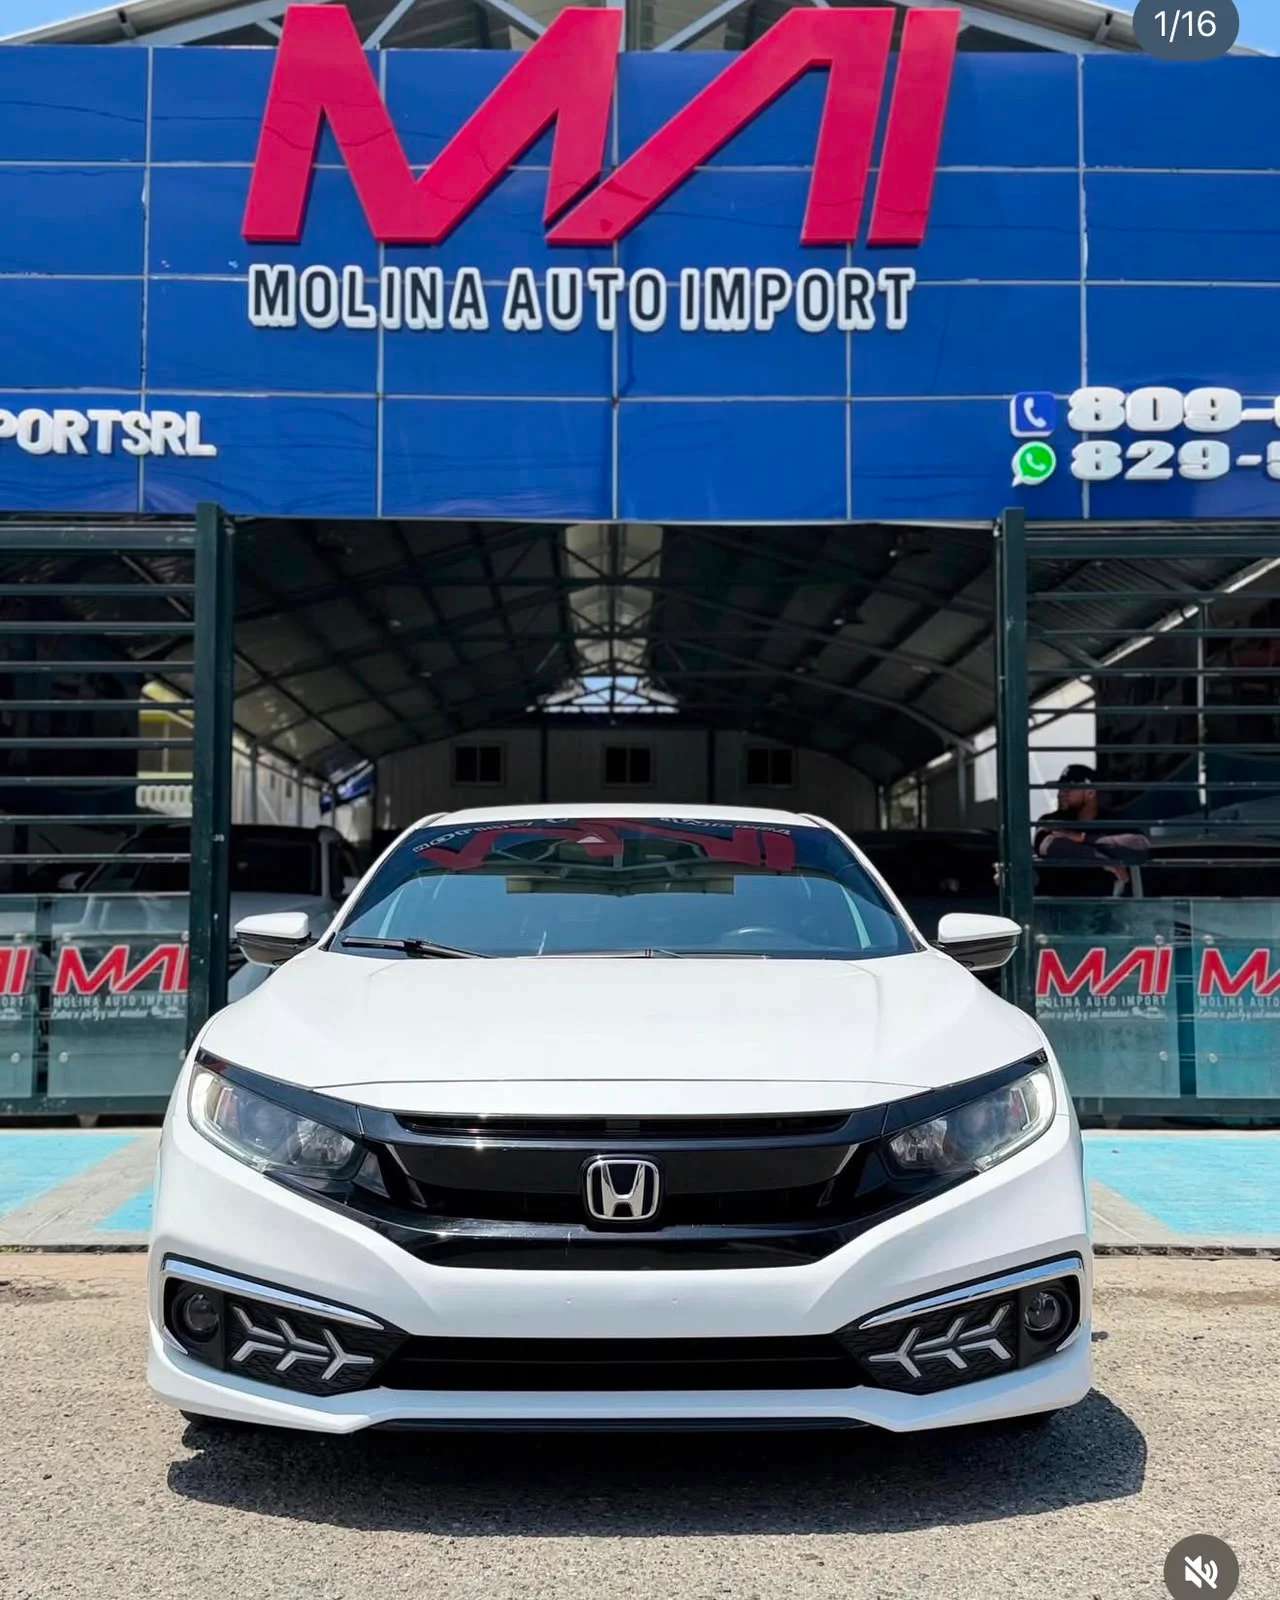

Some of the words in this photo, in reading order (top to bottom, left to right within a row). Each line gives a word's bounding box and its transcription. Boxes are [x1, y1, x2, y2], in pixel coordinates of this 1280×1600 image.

[242, 4, 960, 247] MAI
[248, 264, 488, 330] MOLINA
[503, 267, 666, 332] AUTO
[680, 267, 915, 332] IMPORT
[1067, 386, 1280, 433] 809-
[1035, 946, 1173, 997] MAI
[105, 995, 136, 1006] AUTO
[1086, 995, 1116, 1007] AUTO
[1122, 995, 1166, 1006] IMPORT
